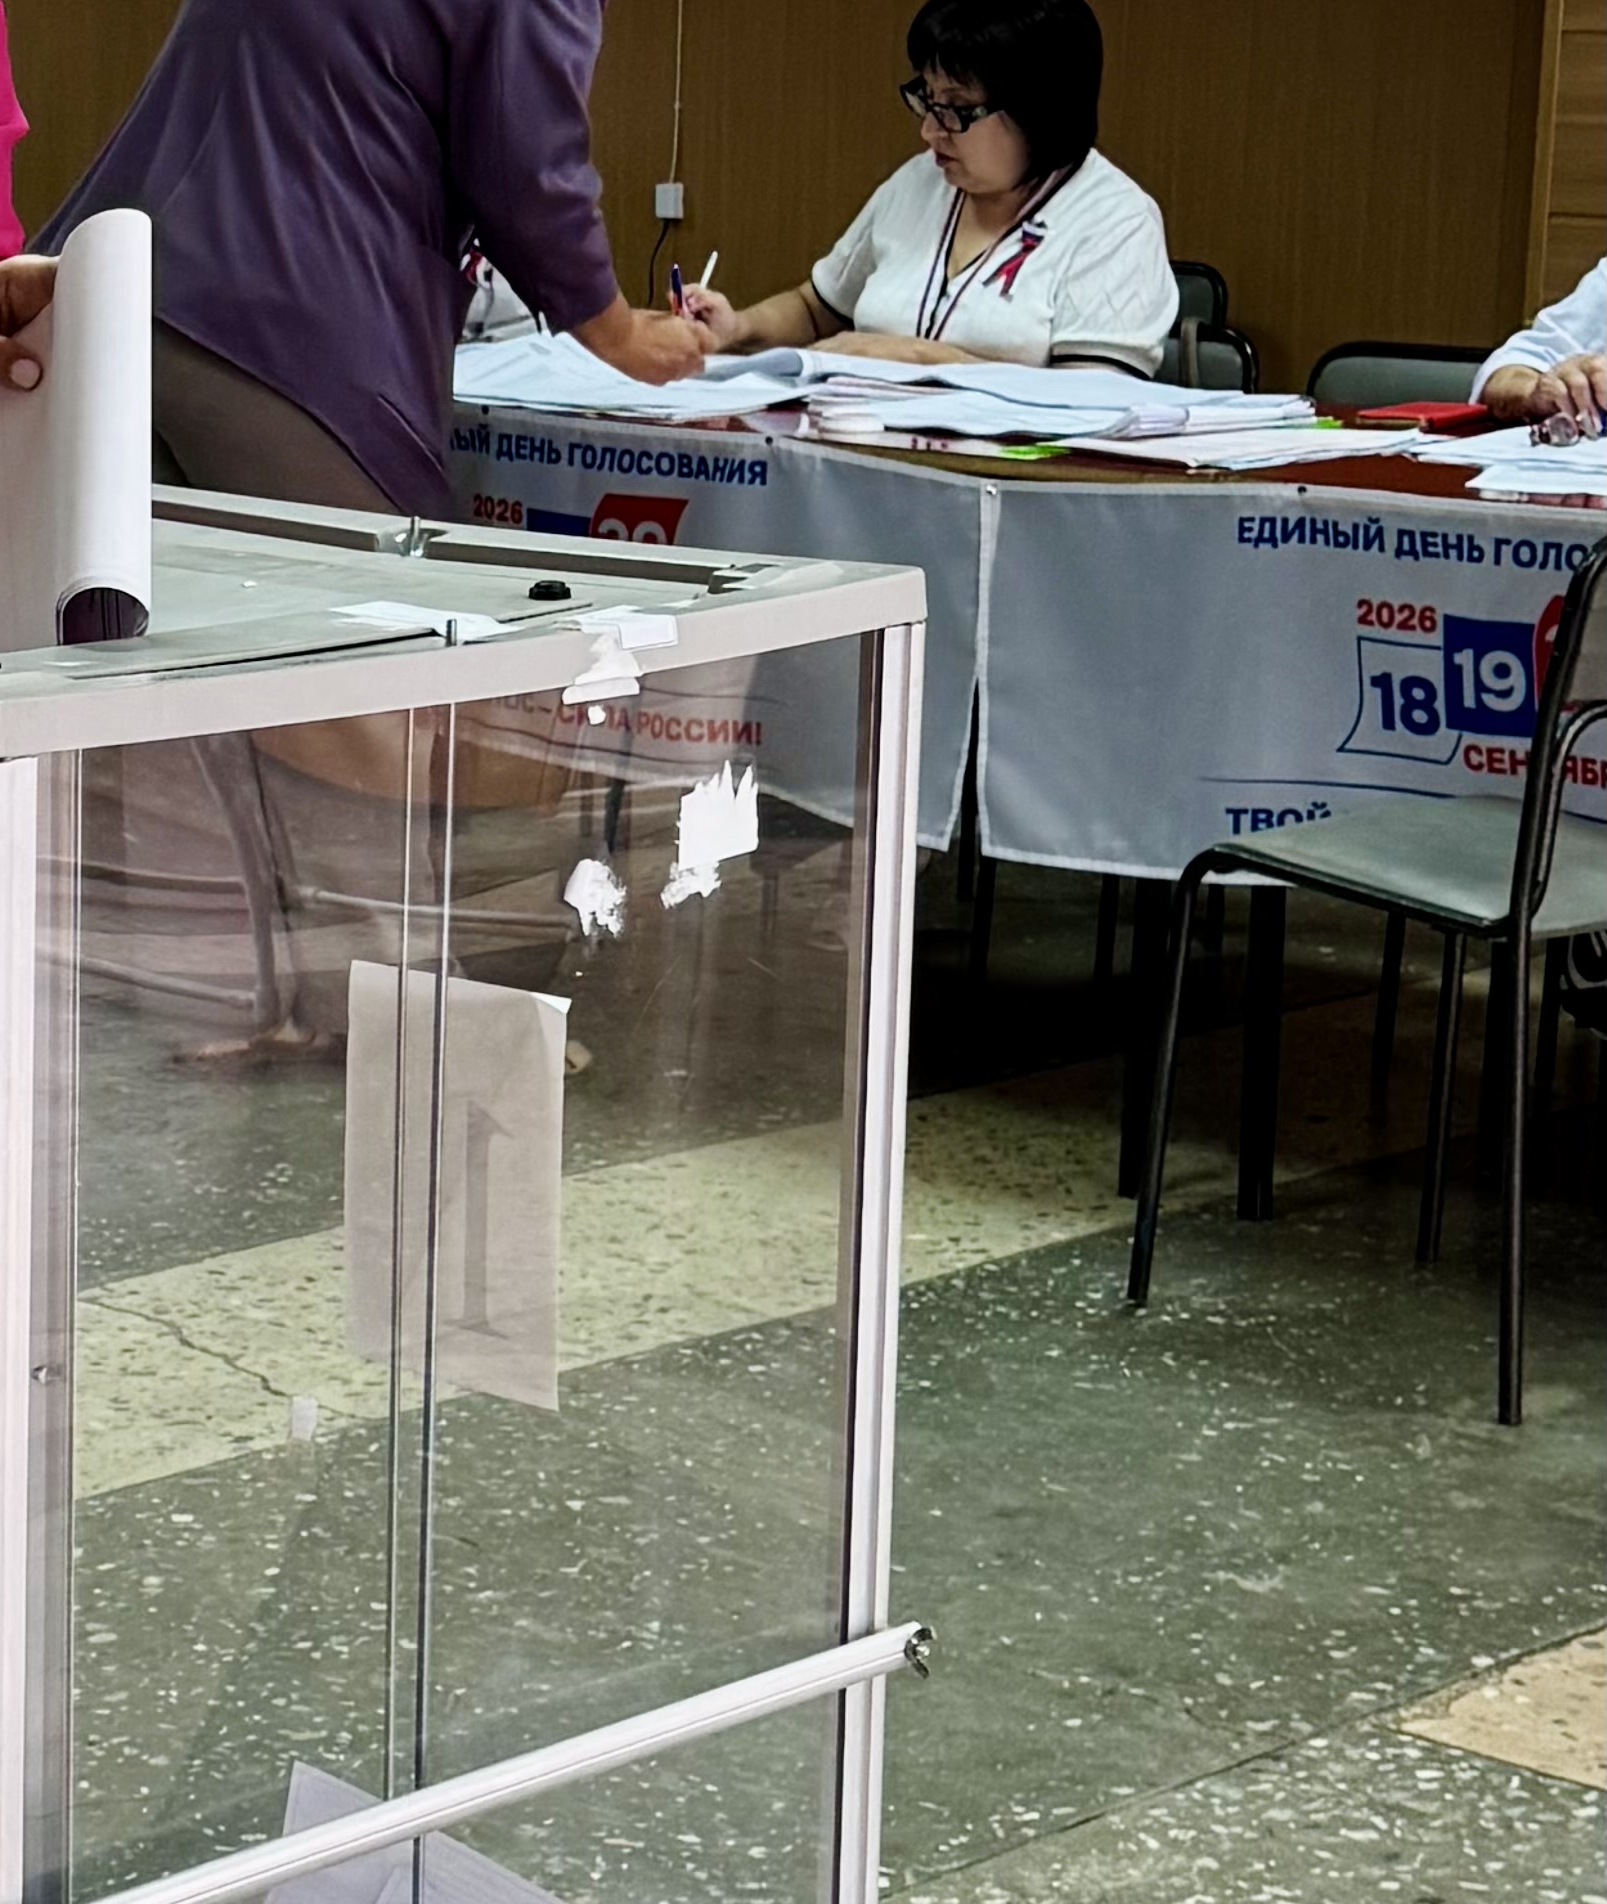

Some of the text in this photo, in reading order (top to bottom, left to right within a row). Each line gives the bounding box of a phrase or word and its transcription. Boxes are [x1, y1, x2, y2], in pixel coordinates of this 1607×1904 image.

[496, 432, 562, 465] ДЕНЬ
[567, 441, 768, 487] ГОЛОСОВАНИЯ
[473, 493, 524, 526] 2026
[1237, 515, 1385, 553] ЕДИНЫЙ
[1394, 528, 1485, 564] ДЕНЬ
[1356, 598, 1438, 633] 2026
[1370, 648, 1527, 737] 18 19
[637, 711, 762, 746] РОССИИ!
